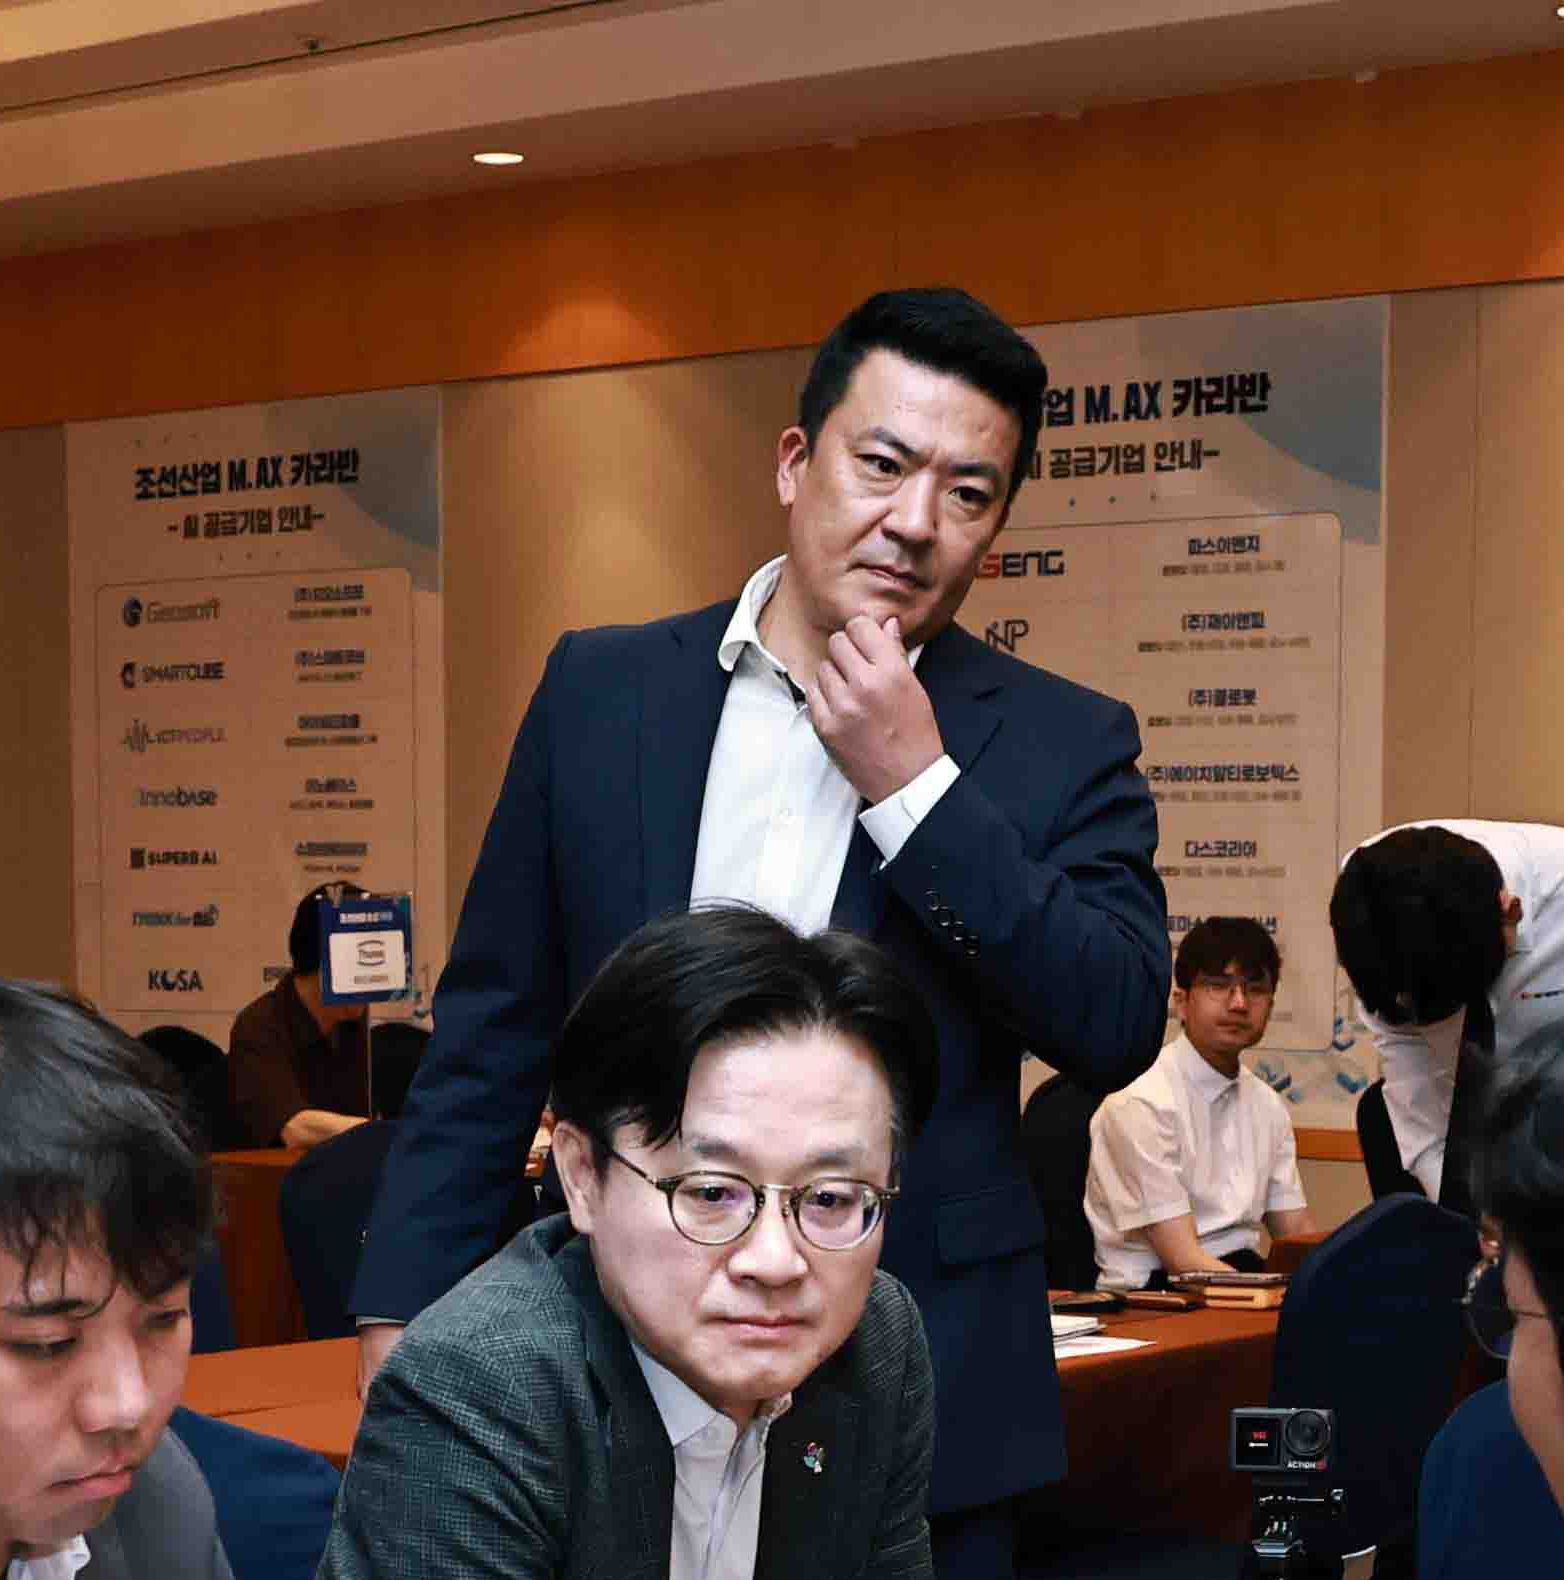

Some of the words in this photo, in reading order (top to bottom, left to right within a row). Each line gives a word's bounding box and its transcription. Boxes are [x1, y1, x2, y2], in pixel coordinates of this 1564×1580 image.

[1084, 380, 1162, 424] M.AX
[1172, 372, 1271, 417] 카라반
[134, 460, 221, 501] 조선산업
[228, 456, 283, 491] M.AX
[289, 448, 360, 486] 카라반
[1049, 443, 1145, 480] 공급기업
